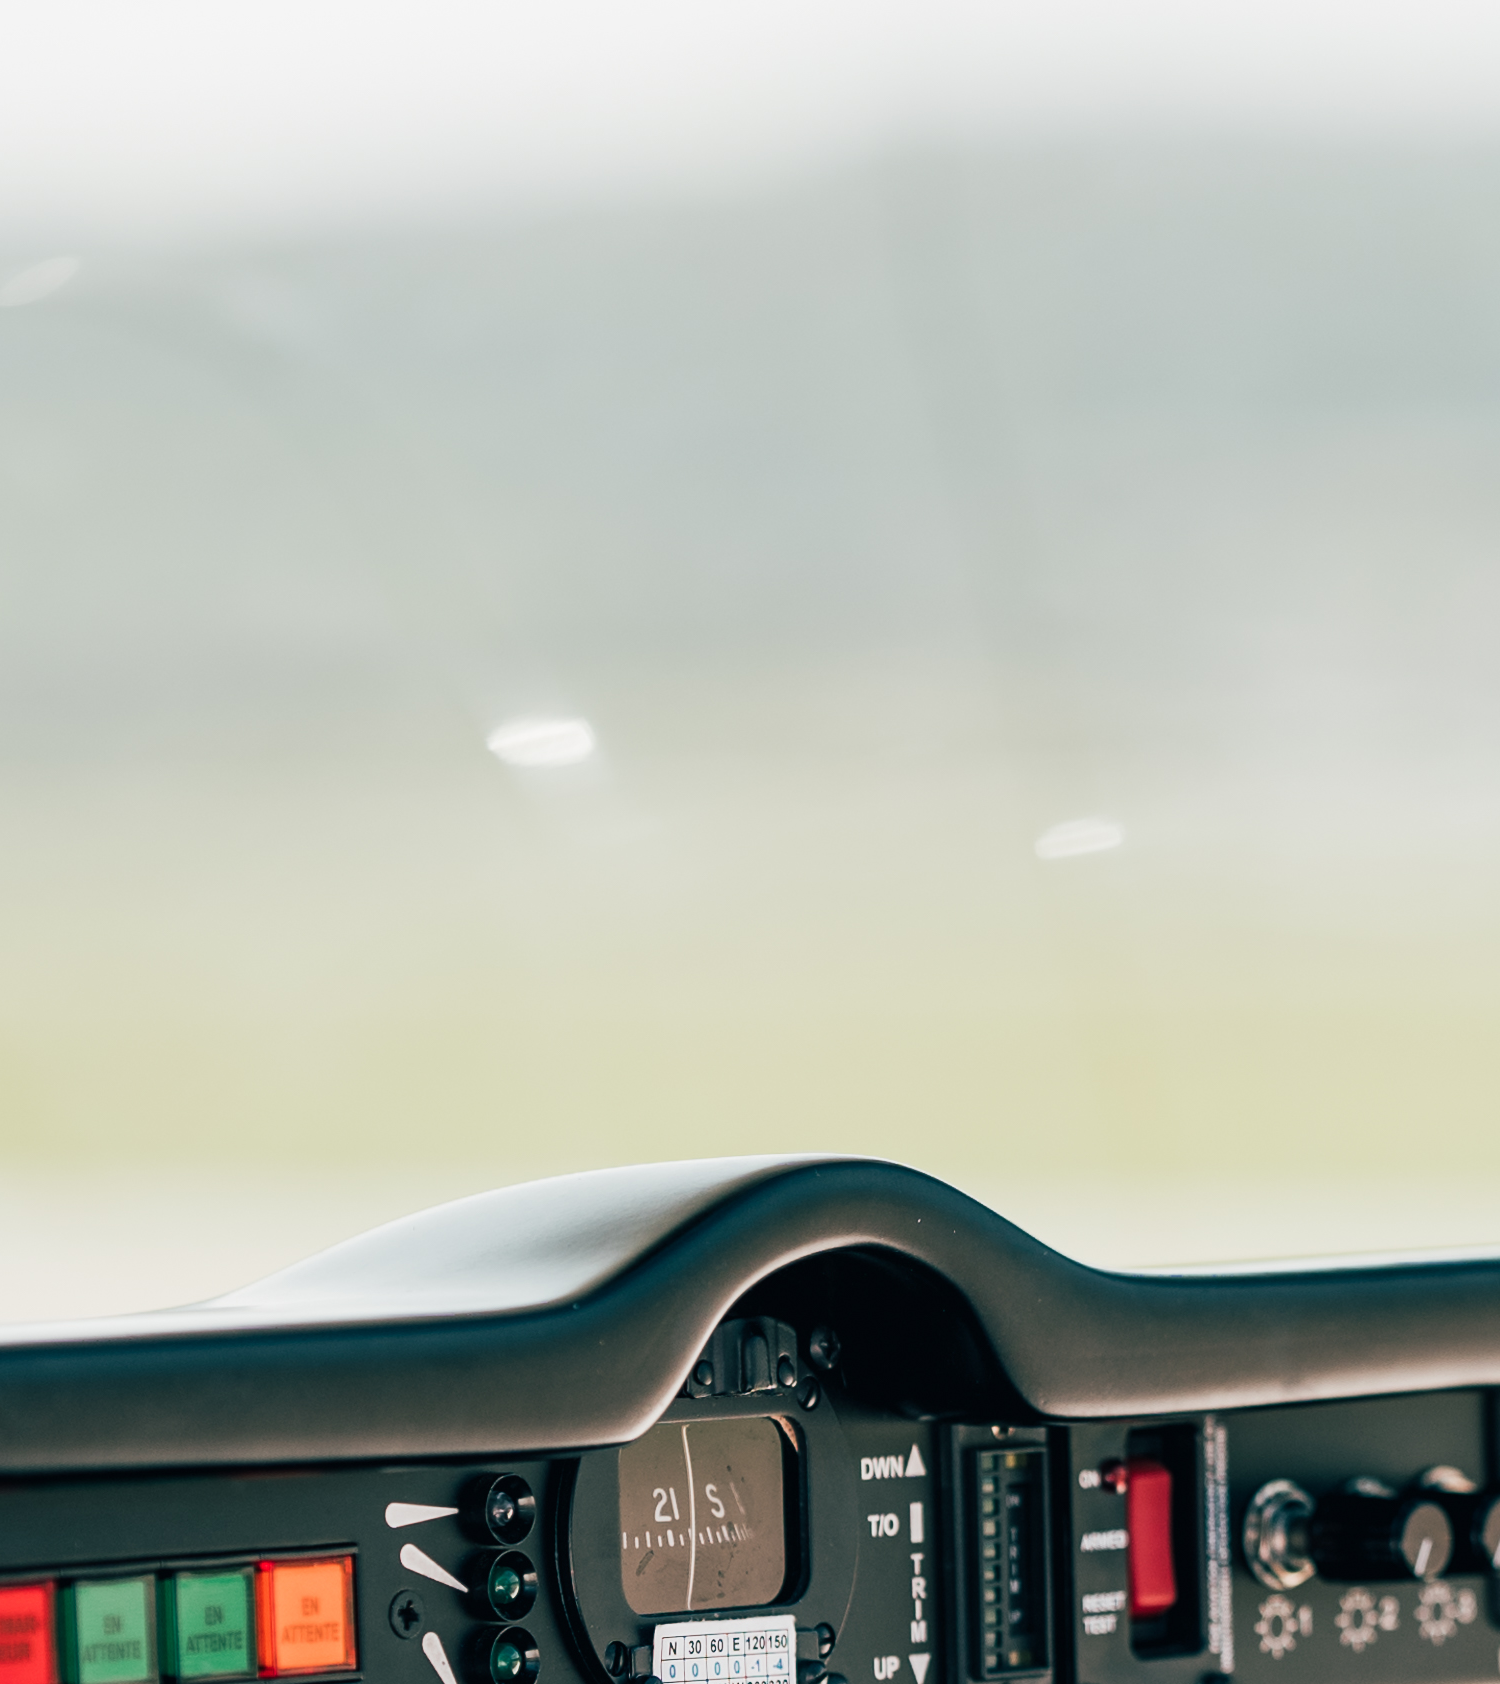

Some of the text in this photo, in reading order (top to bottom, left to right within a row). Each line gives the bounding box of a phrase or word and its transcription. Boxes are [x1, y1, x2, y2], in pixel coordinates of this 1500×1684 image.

[861, 1455, 904, 1480] DWN
[867, 1513, 900, 1537] T/O
[302, 1596, 320, 1617] EN
[910, 1553, 927, 1643] TRIM
[204, 1605, 223, 1627] EN
[186, 1629, 243, 1655] ATTENTE
[281, 1621, 340, 1645] ATTENTE
[668, 1634, 787, 1656] N 30 60 E 120 150
[82, 1639, 142, 1664] ATTENTE
[669, 1658, 783, 1679] 0 0 0 0 -1 -4
[873, 1655, 900, 1681] UP
